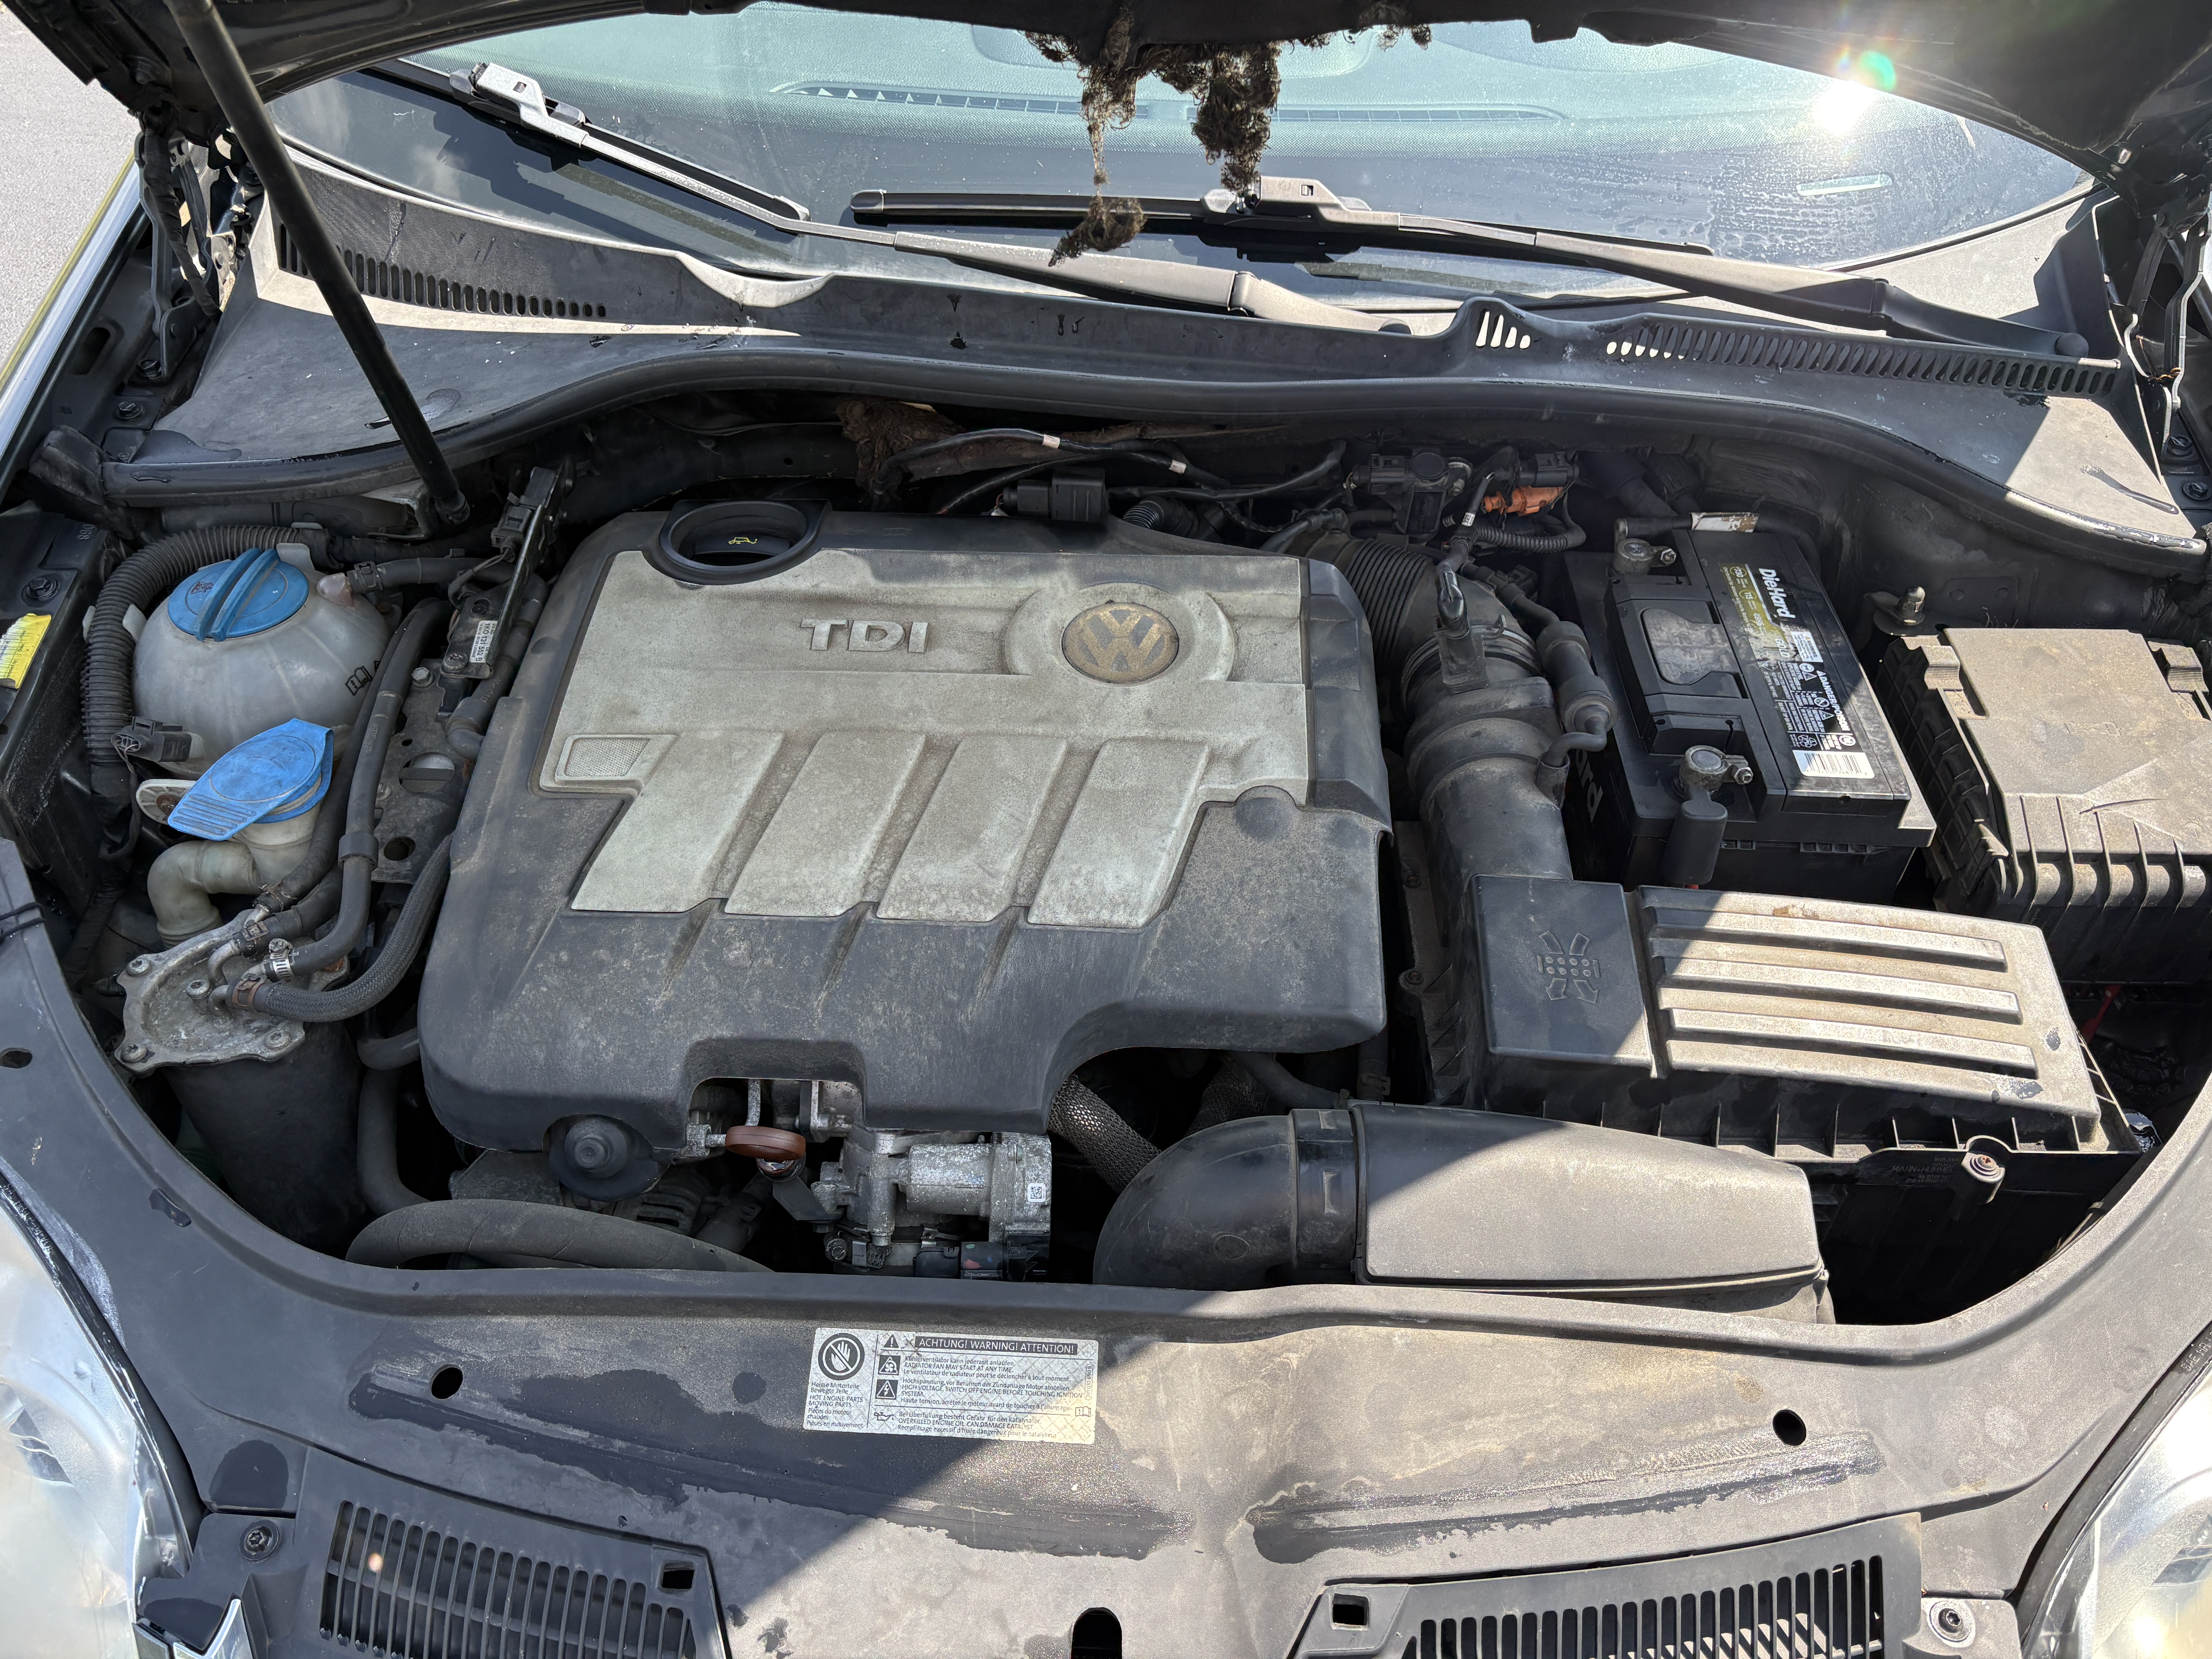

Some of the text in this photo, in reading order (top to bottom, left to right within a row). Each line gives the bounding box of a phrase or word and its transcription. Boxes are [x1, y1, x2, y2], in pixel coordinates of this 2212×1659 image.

[1759, 568, 1796, 618] DieHard
[800, 619, 929, 653] TDI
[1066, 604, 1176, 680] VW
[477, 646, 485, 656] 552
[1775, 639, 1790, 658] GOLD
[1820, 677, 1850, 732] DANGER/POISON
[919, 1338, 1073, 1353] ACHTUNG! WARNING! ATTENTION!
[2181, 1353, 2201, 1371] SAE
[898, 1424, 932, 1432] Remplissage
